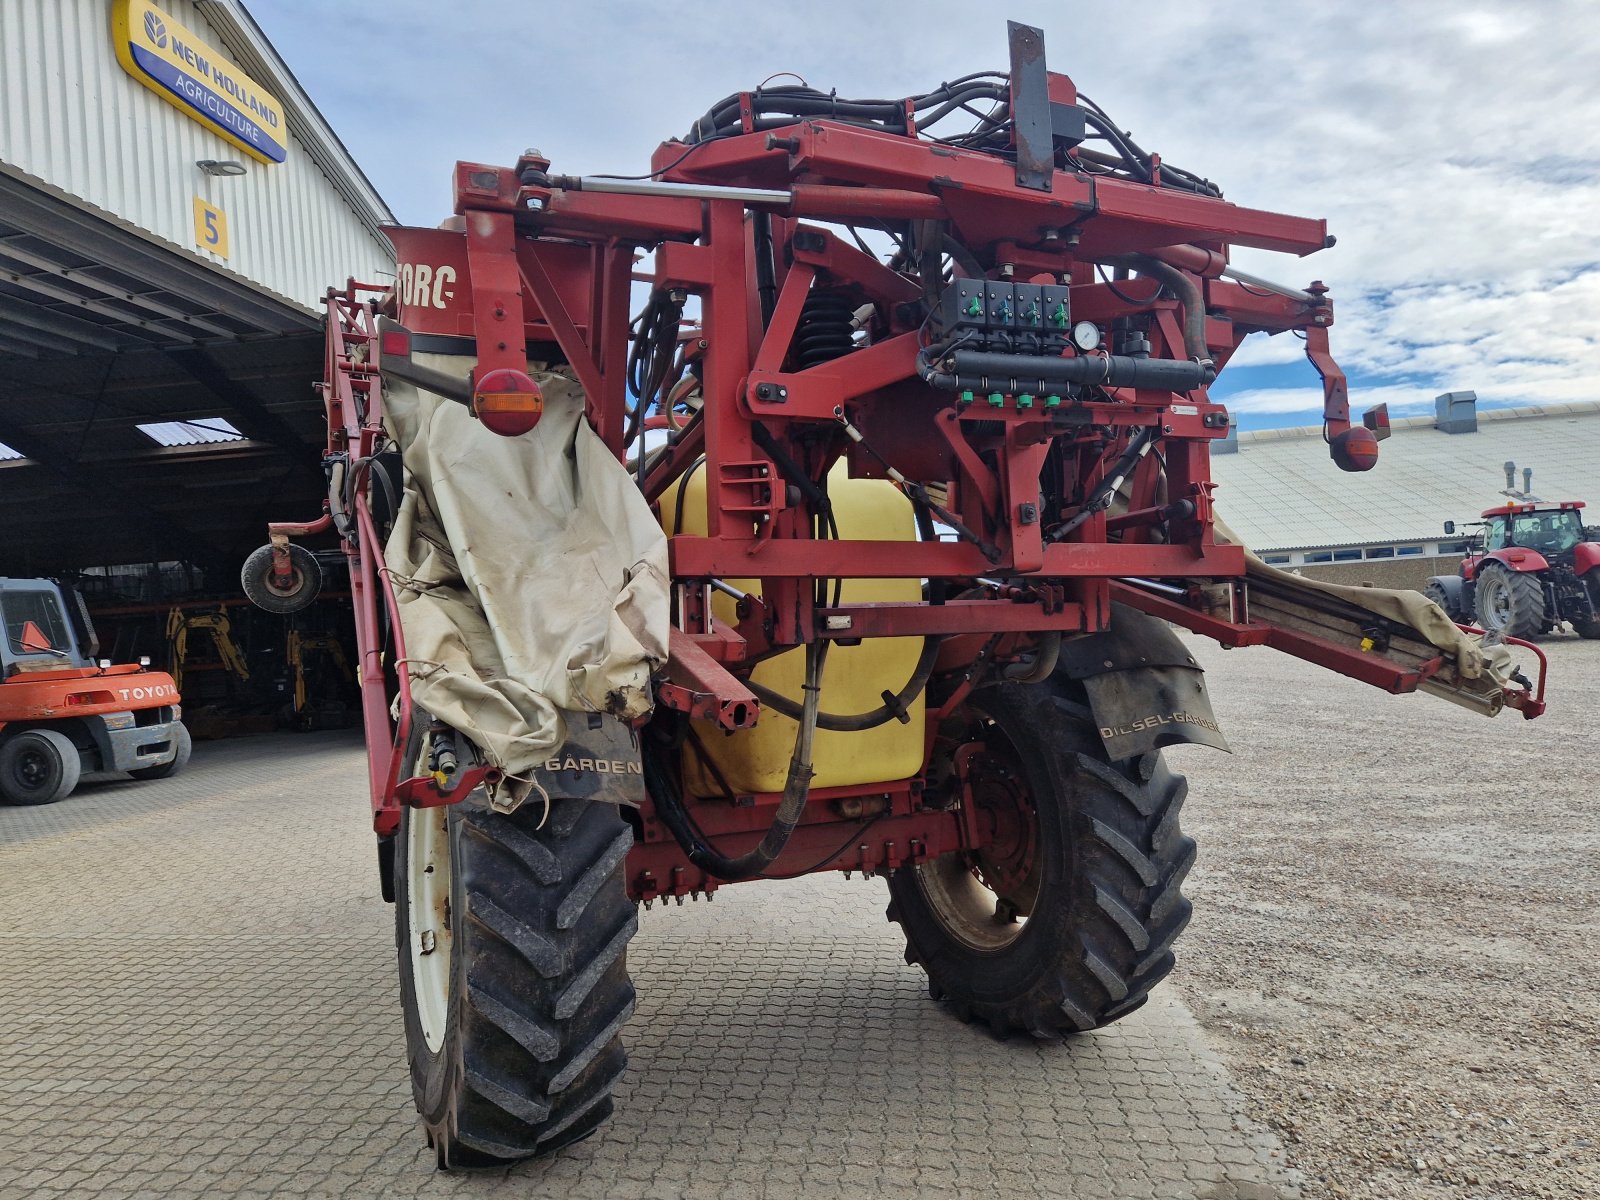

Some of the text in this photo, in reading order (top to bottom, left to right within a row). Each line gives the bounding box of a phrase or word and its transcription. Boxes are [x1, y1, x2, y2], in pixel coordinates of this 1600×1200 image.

[172, 35, 278, 128] NEW HOLLAND
[175, 75, 259, 143] AGRICULTURE
[204, 209, 219, 245] 5
[118, 684, 177, 701] TOYOTA
